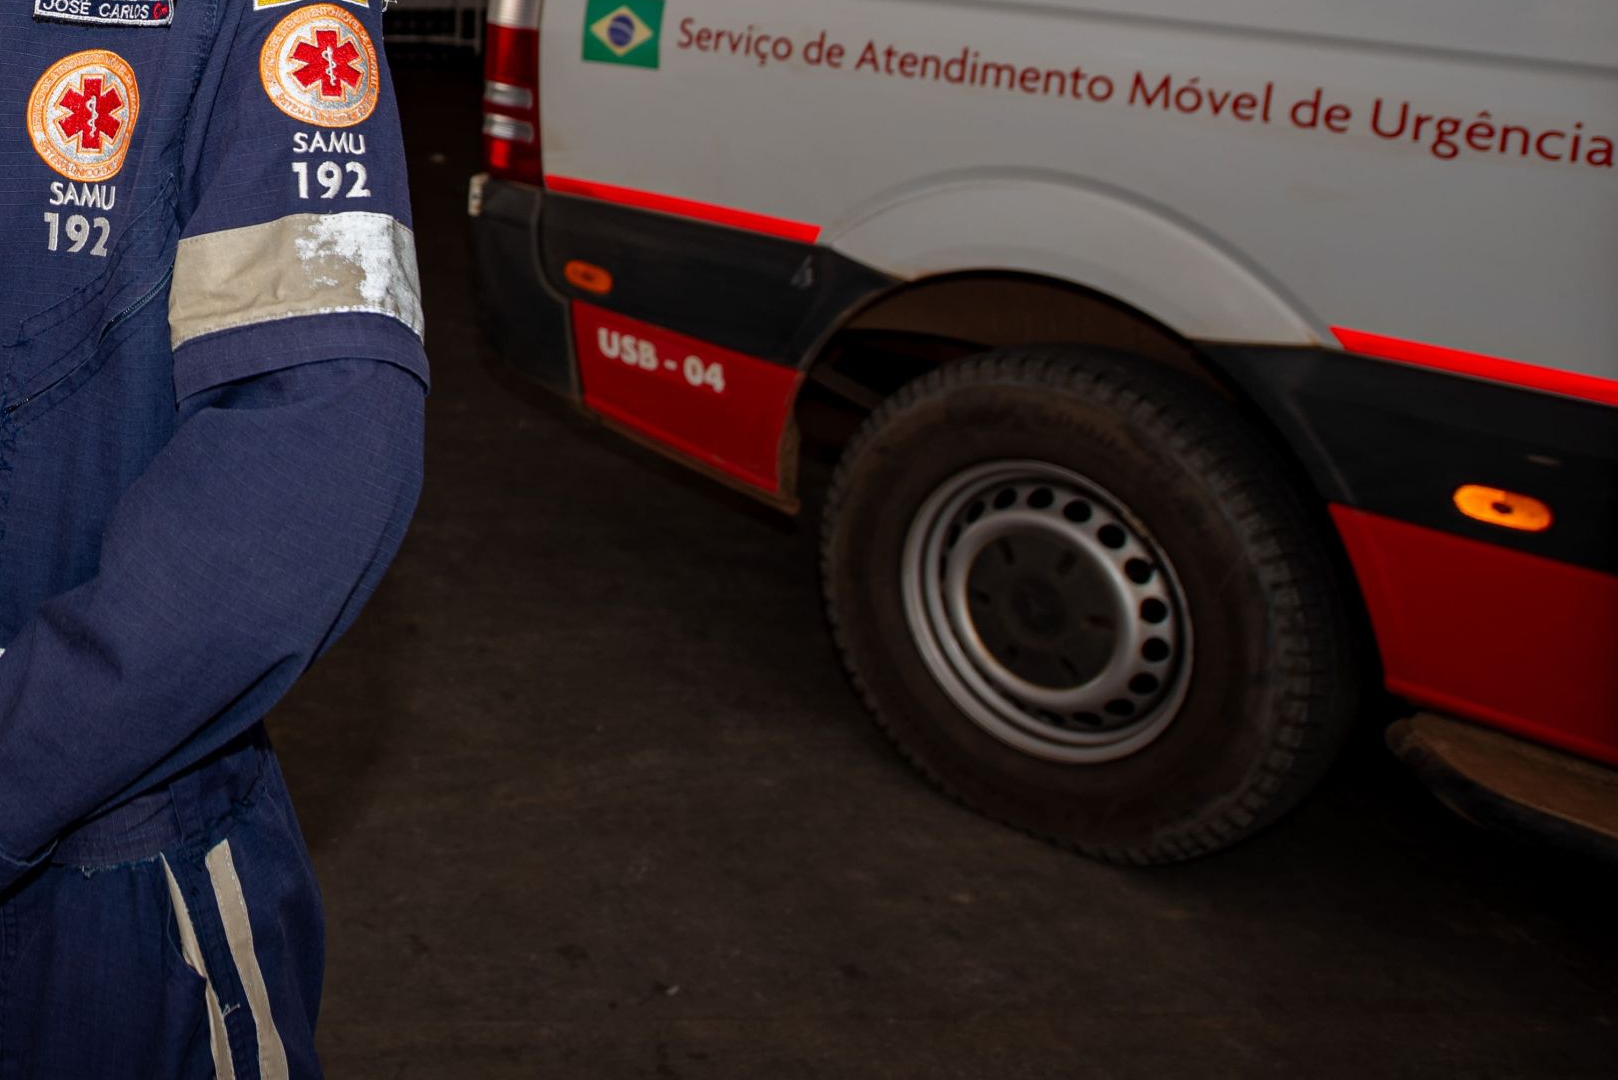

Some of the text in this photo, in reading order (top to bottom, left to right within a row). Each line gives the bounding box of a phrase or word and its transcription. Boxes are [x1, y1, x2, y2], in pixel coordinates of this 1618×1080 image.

[98, 3, 149, 19] CARLOS
[676, 15, 1616, 169] Serviço de Atendimento Móvel de Urgência
[293, 131, 366, 155] SAMU
[49, 182, 116, 210] SAMU
[292, 162, 371, 200] 192
[44, 212, 110, 257] 192
[598, 327, 657, 370] USB
[683, 354, 726, 392] 04
